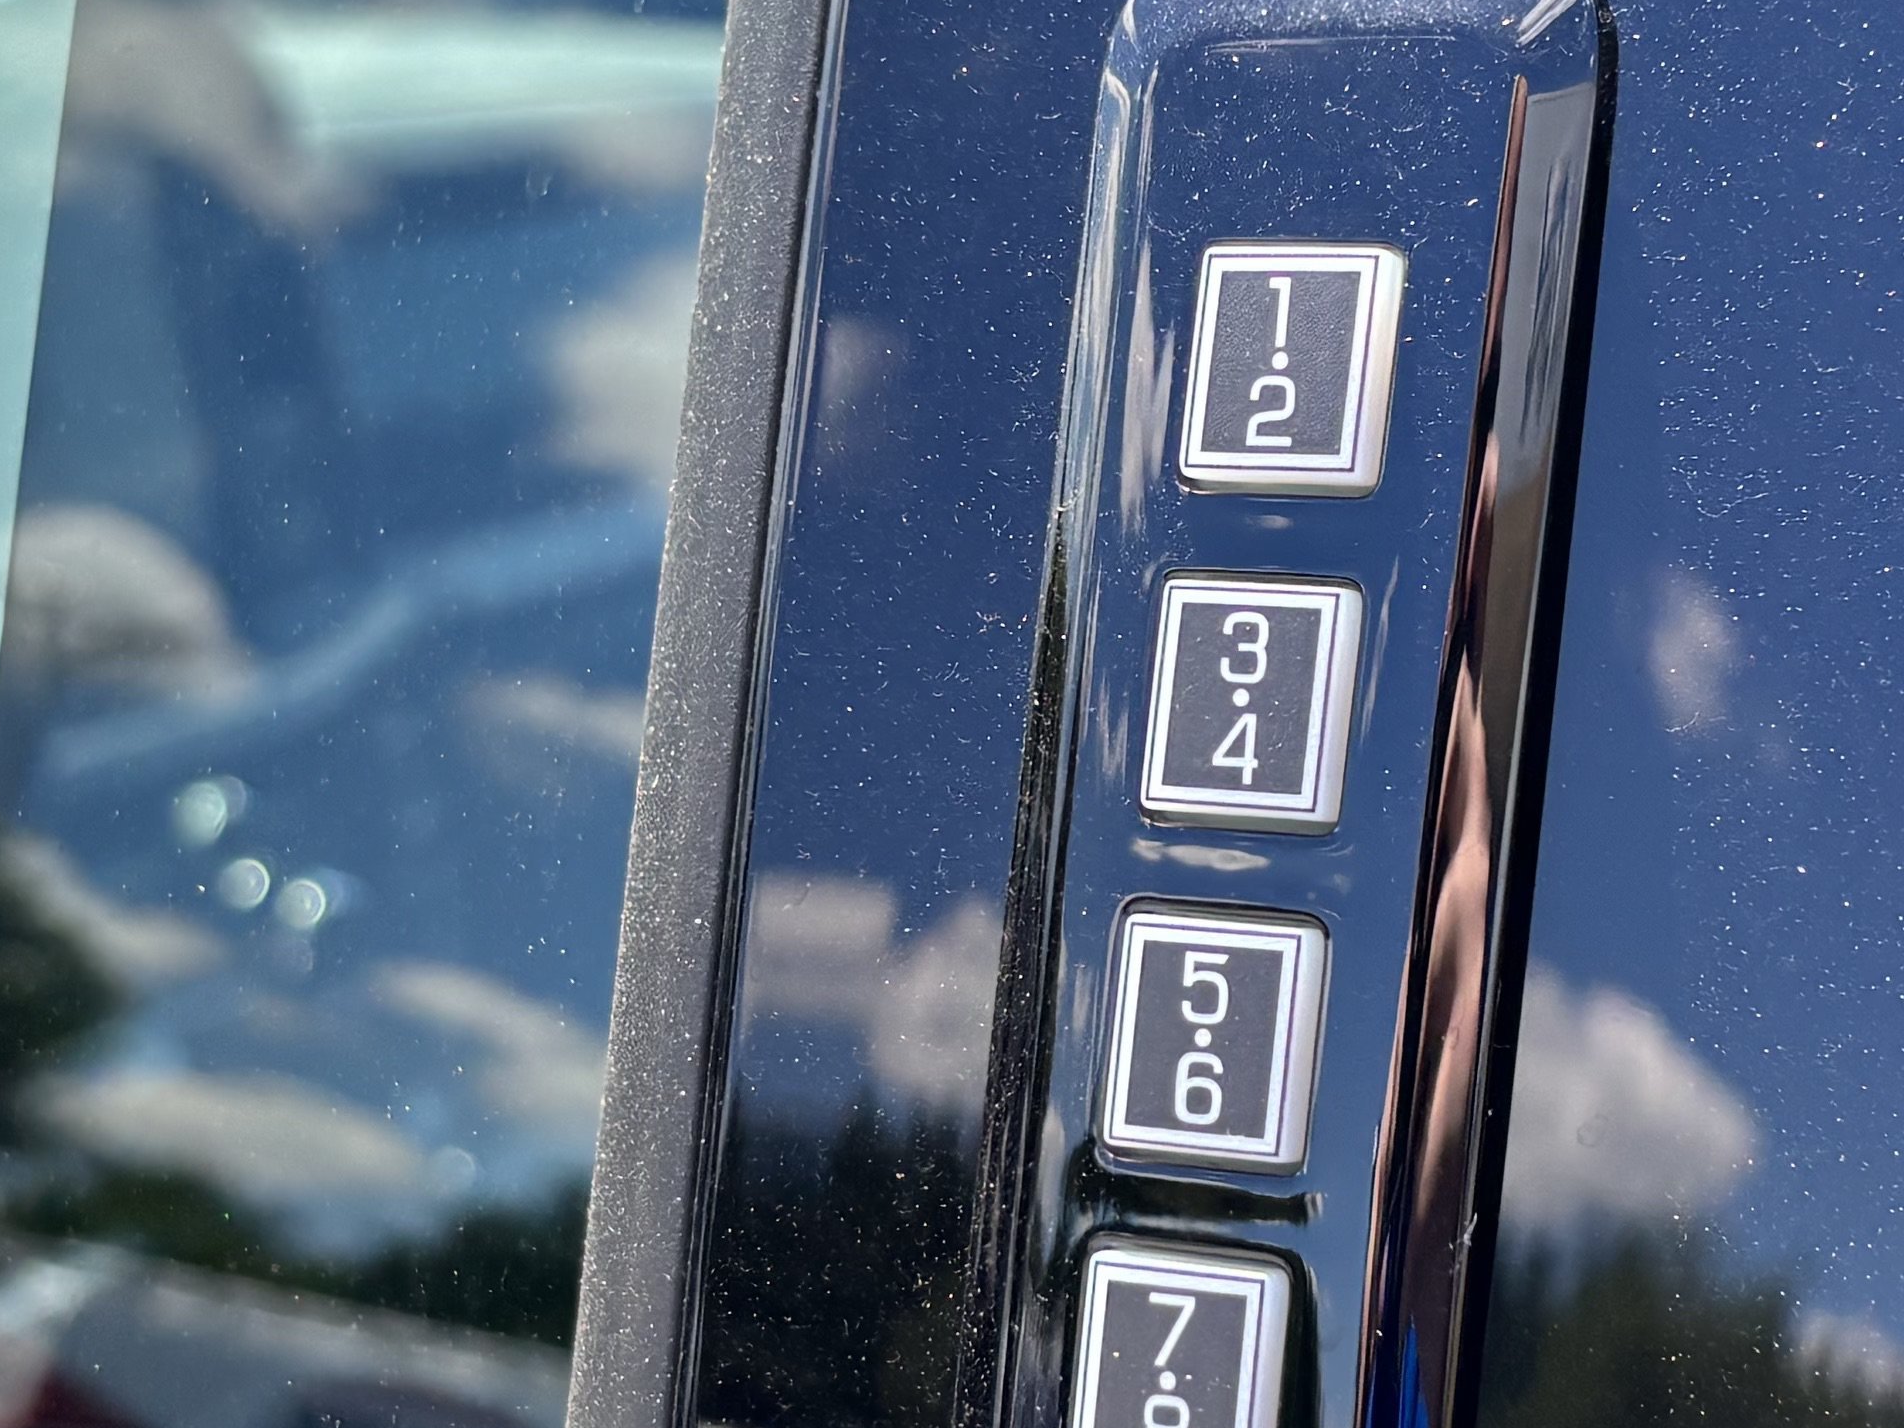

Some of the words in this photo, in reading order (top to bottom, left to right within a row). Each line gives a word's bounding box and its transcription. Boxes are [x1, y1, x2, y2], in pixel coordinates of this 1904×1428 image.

[1268, 277, 1292, 348] 1
[1245, 375, 1296, 447] 2
[1220, 611, 1270, 684] 3
[1212, 713, 1259, 785] 4
[1181, 950, 1230, 1025] 5
[1174, 1051, 1224, 1125] 6
[1148, 1292, 1196, 1367] 7
